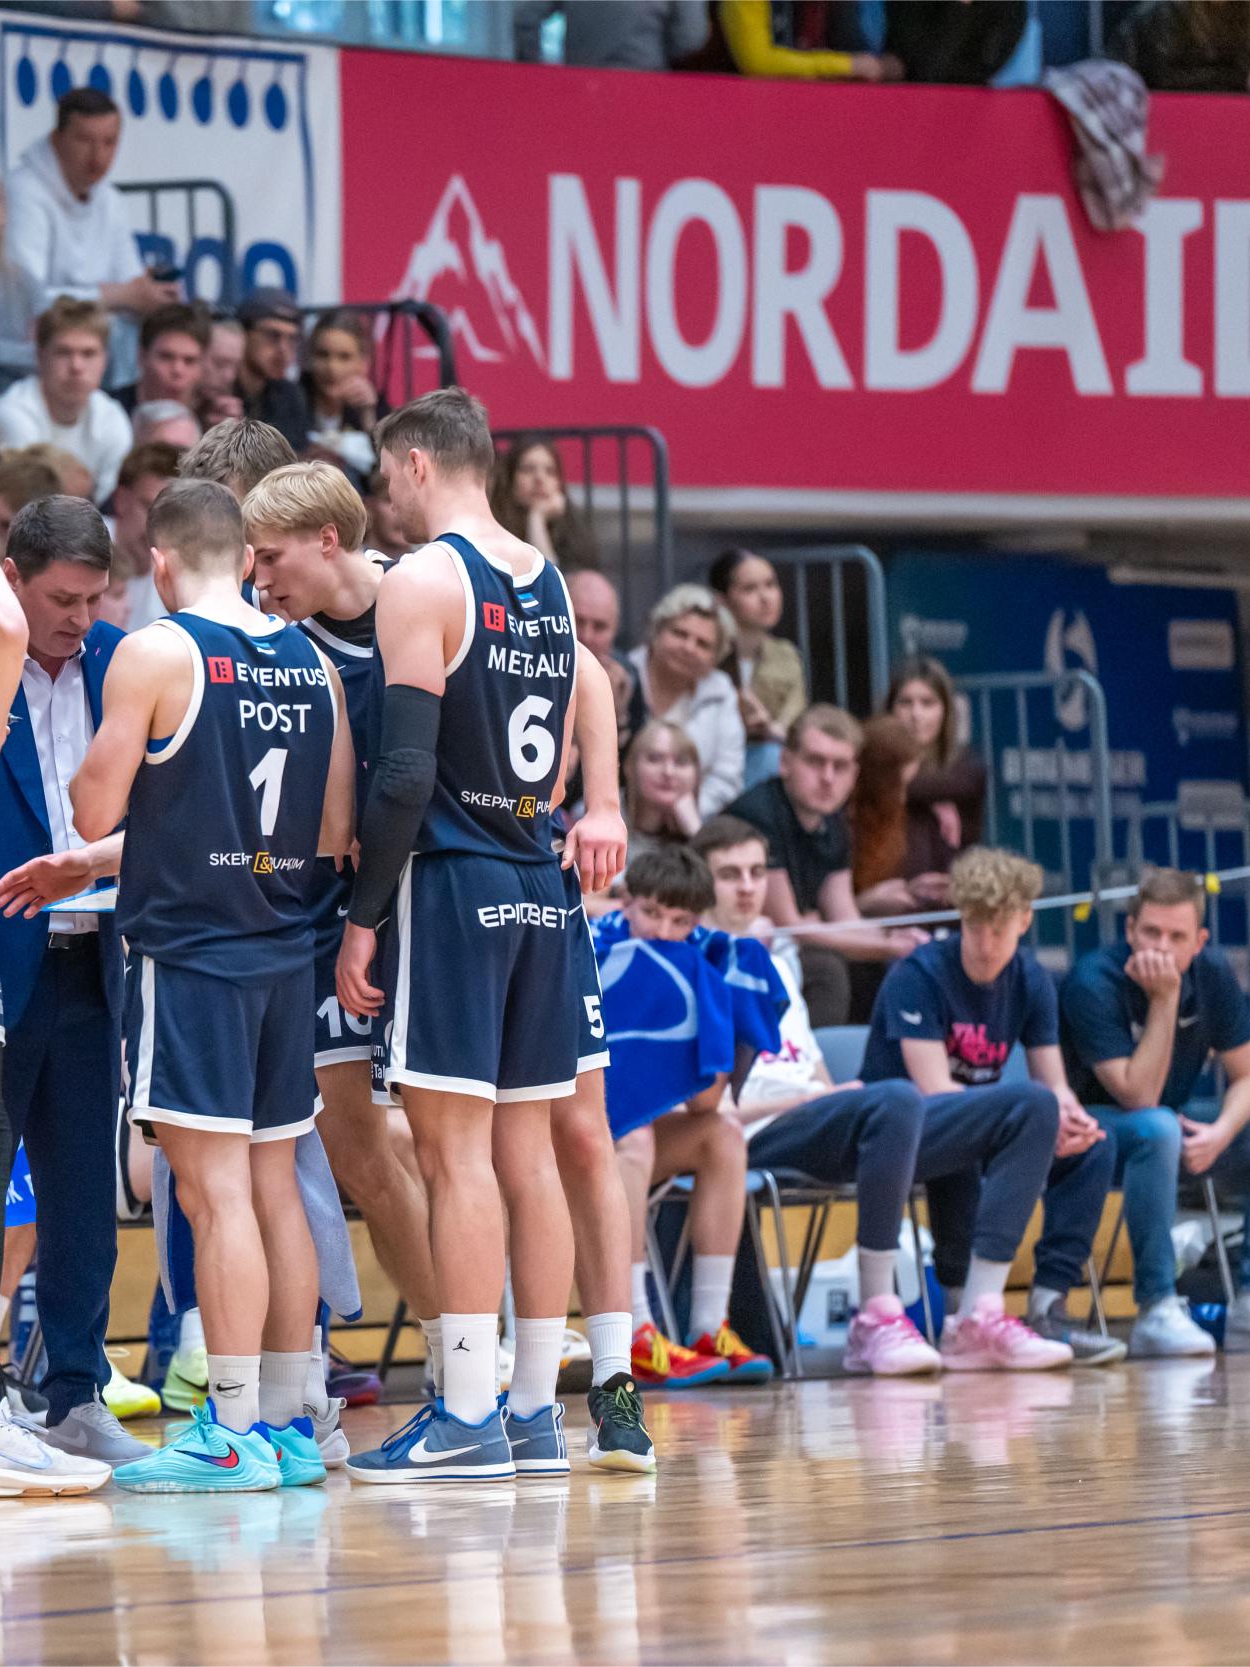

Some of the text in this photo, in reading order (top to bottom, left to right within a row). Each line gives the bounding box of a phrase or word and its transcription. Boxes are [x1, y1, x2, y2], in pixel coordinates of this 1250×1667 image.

[507, 612, 570, 637] EVETUS
[236, 662, 327, 687] EVENTUS
[239, 699, 312, 734] POST
[508, 694, 556, 783] 6
[249, 747, 288, 836] 1
[477, 902, 568, 931] EPICBET
[583, 994, 605, 1039] 5
